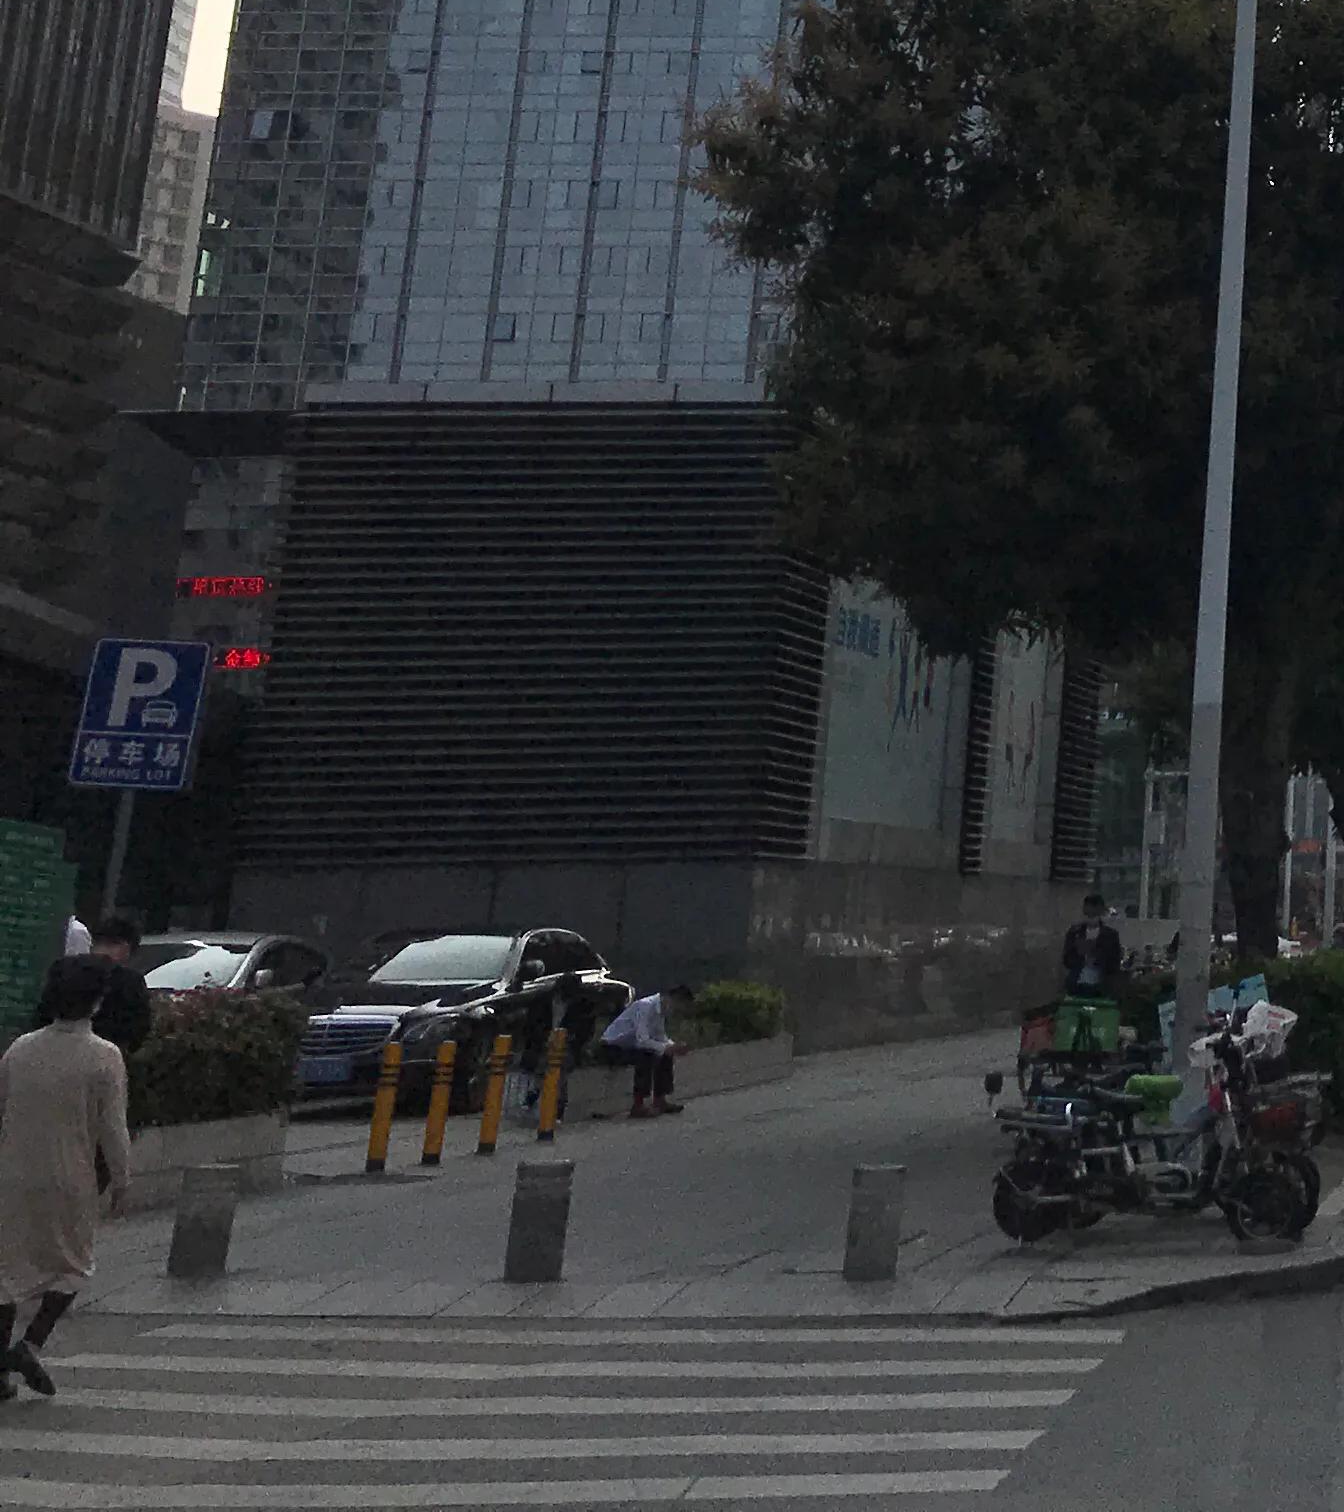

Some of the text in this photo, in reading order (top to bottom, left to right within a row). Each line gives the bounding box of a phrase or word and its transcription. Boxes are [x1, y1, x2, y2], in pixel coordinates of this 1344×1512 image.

[106, 647, 178, 727] P
[82, 738, 181, 768] 停车场
[80, 766, 172, 781] PARKING LOT
